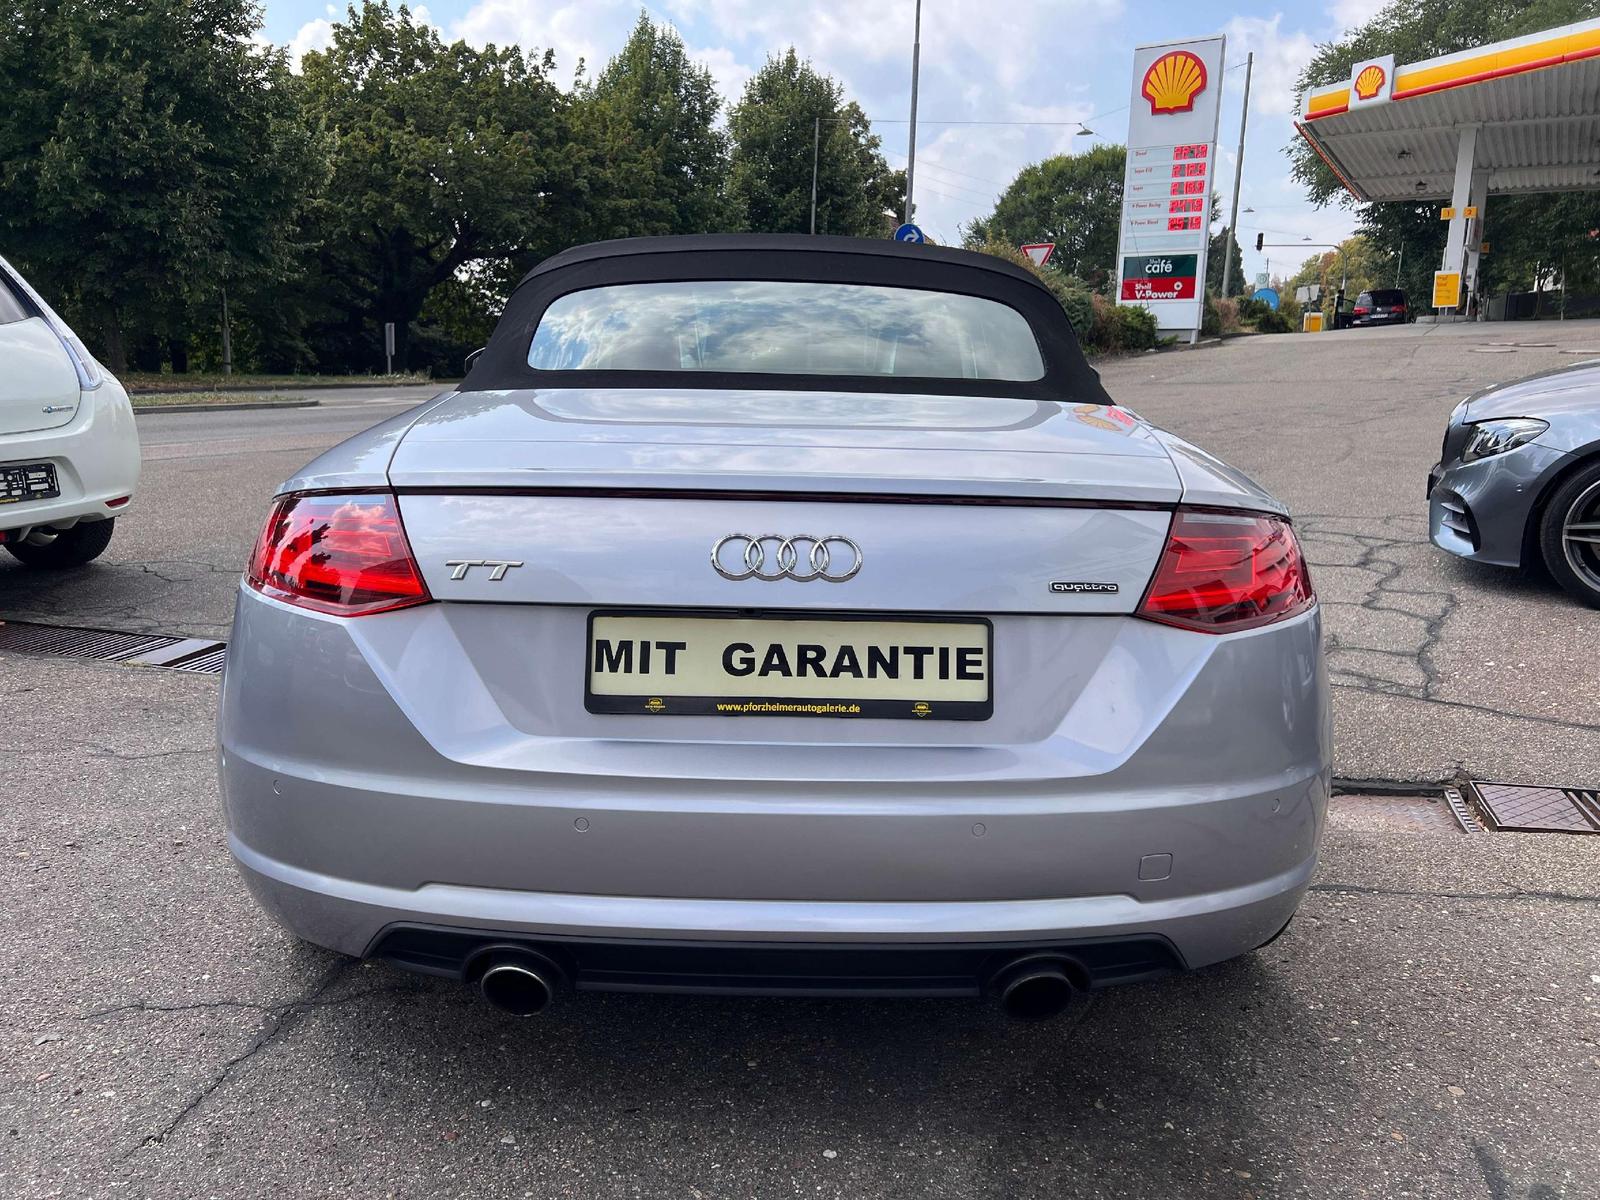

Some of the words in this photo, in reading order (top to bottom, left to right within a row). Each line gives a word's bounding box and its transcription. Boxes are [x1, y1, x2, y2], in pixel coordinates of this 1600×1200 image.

[1145, 259, 1173, 274] café
[1135, 282, 1152, 290] Shell
[1135, 290, 1178, 299] V-Power
[445, 559, 525, 581] TT
[1053, 583, 1117, 592] quattro
[594, 639, 687, 675] MIT
[721, 642, 985, 681] GARANTIE
[716, 702, 861, 714] www.pforzheimerautogalerie.de
